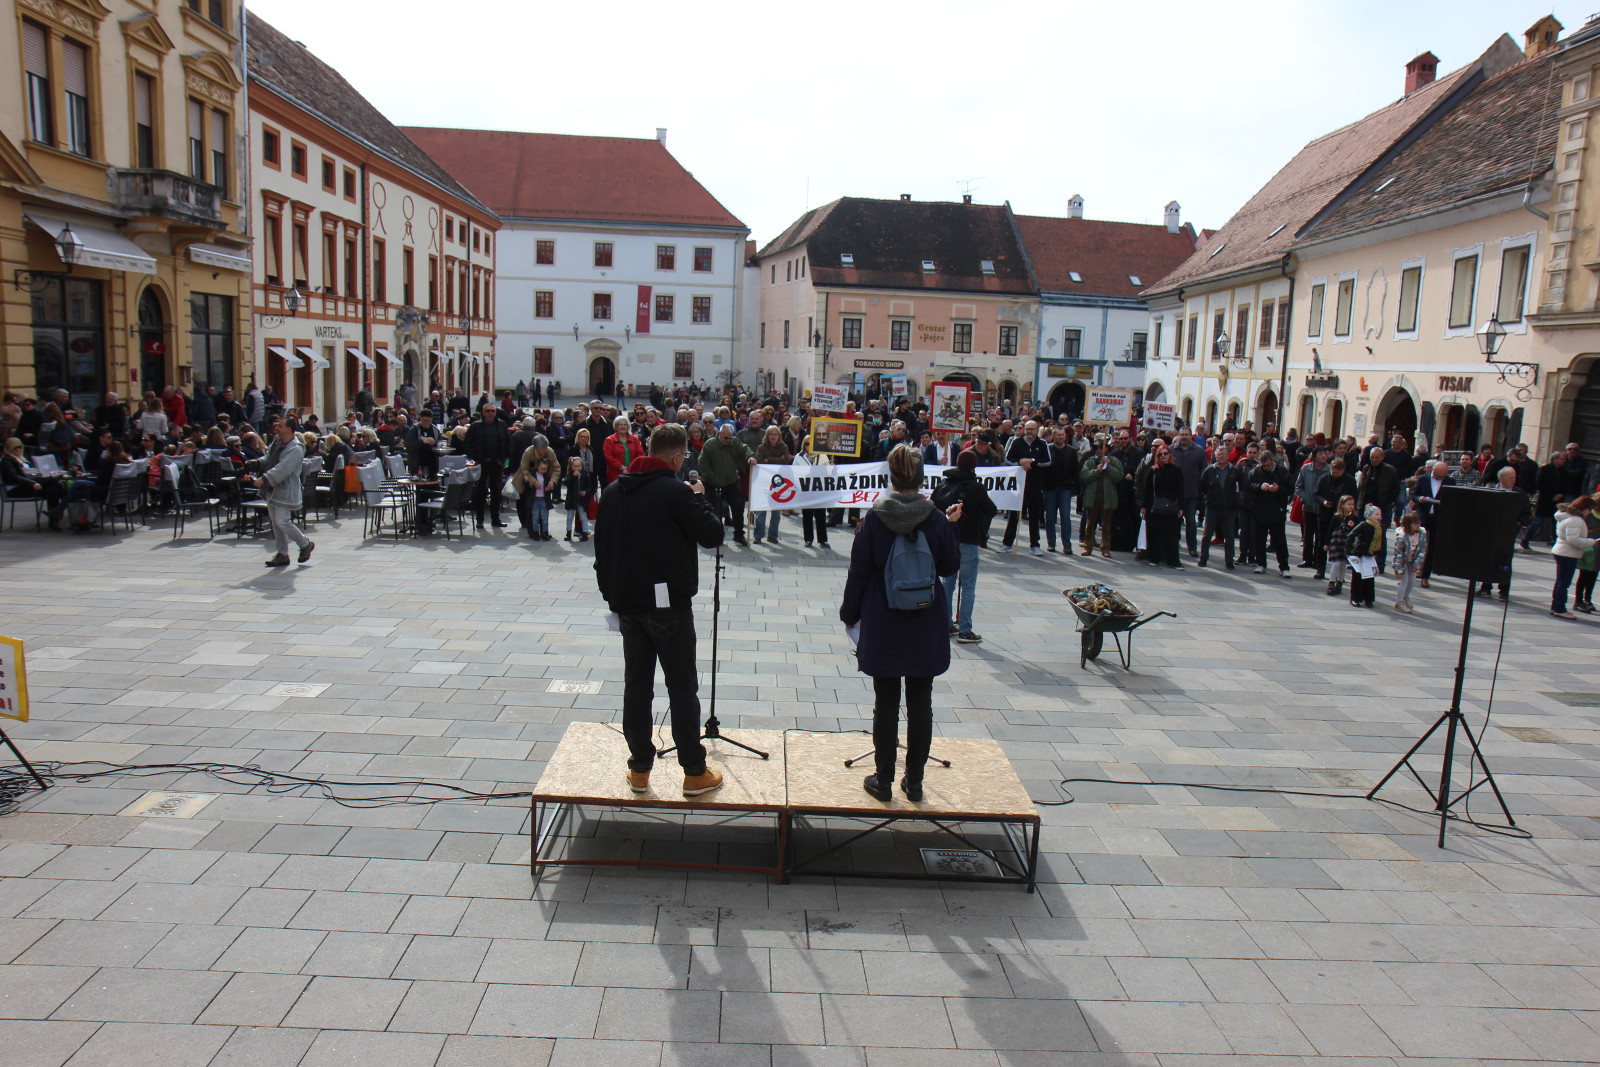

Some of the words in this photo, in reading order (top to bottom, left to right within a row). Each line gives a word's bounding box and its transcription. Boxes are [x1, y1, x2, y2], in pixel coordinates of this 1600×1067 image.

[314, 325, 343, 339] VARTEKS
[1438, 376, 1473, 392] TISAK
[799, 473, 889, 492] VARAŽDIN
[840, 490, 881, 505] BEZ
